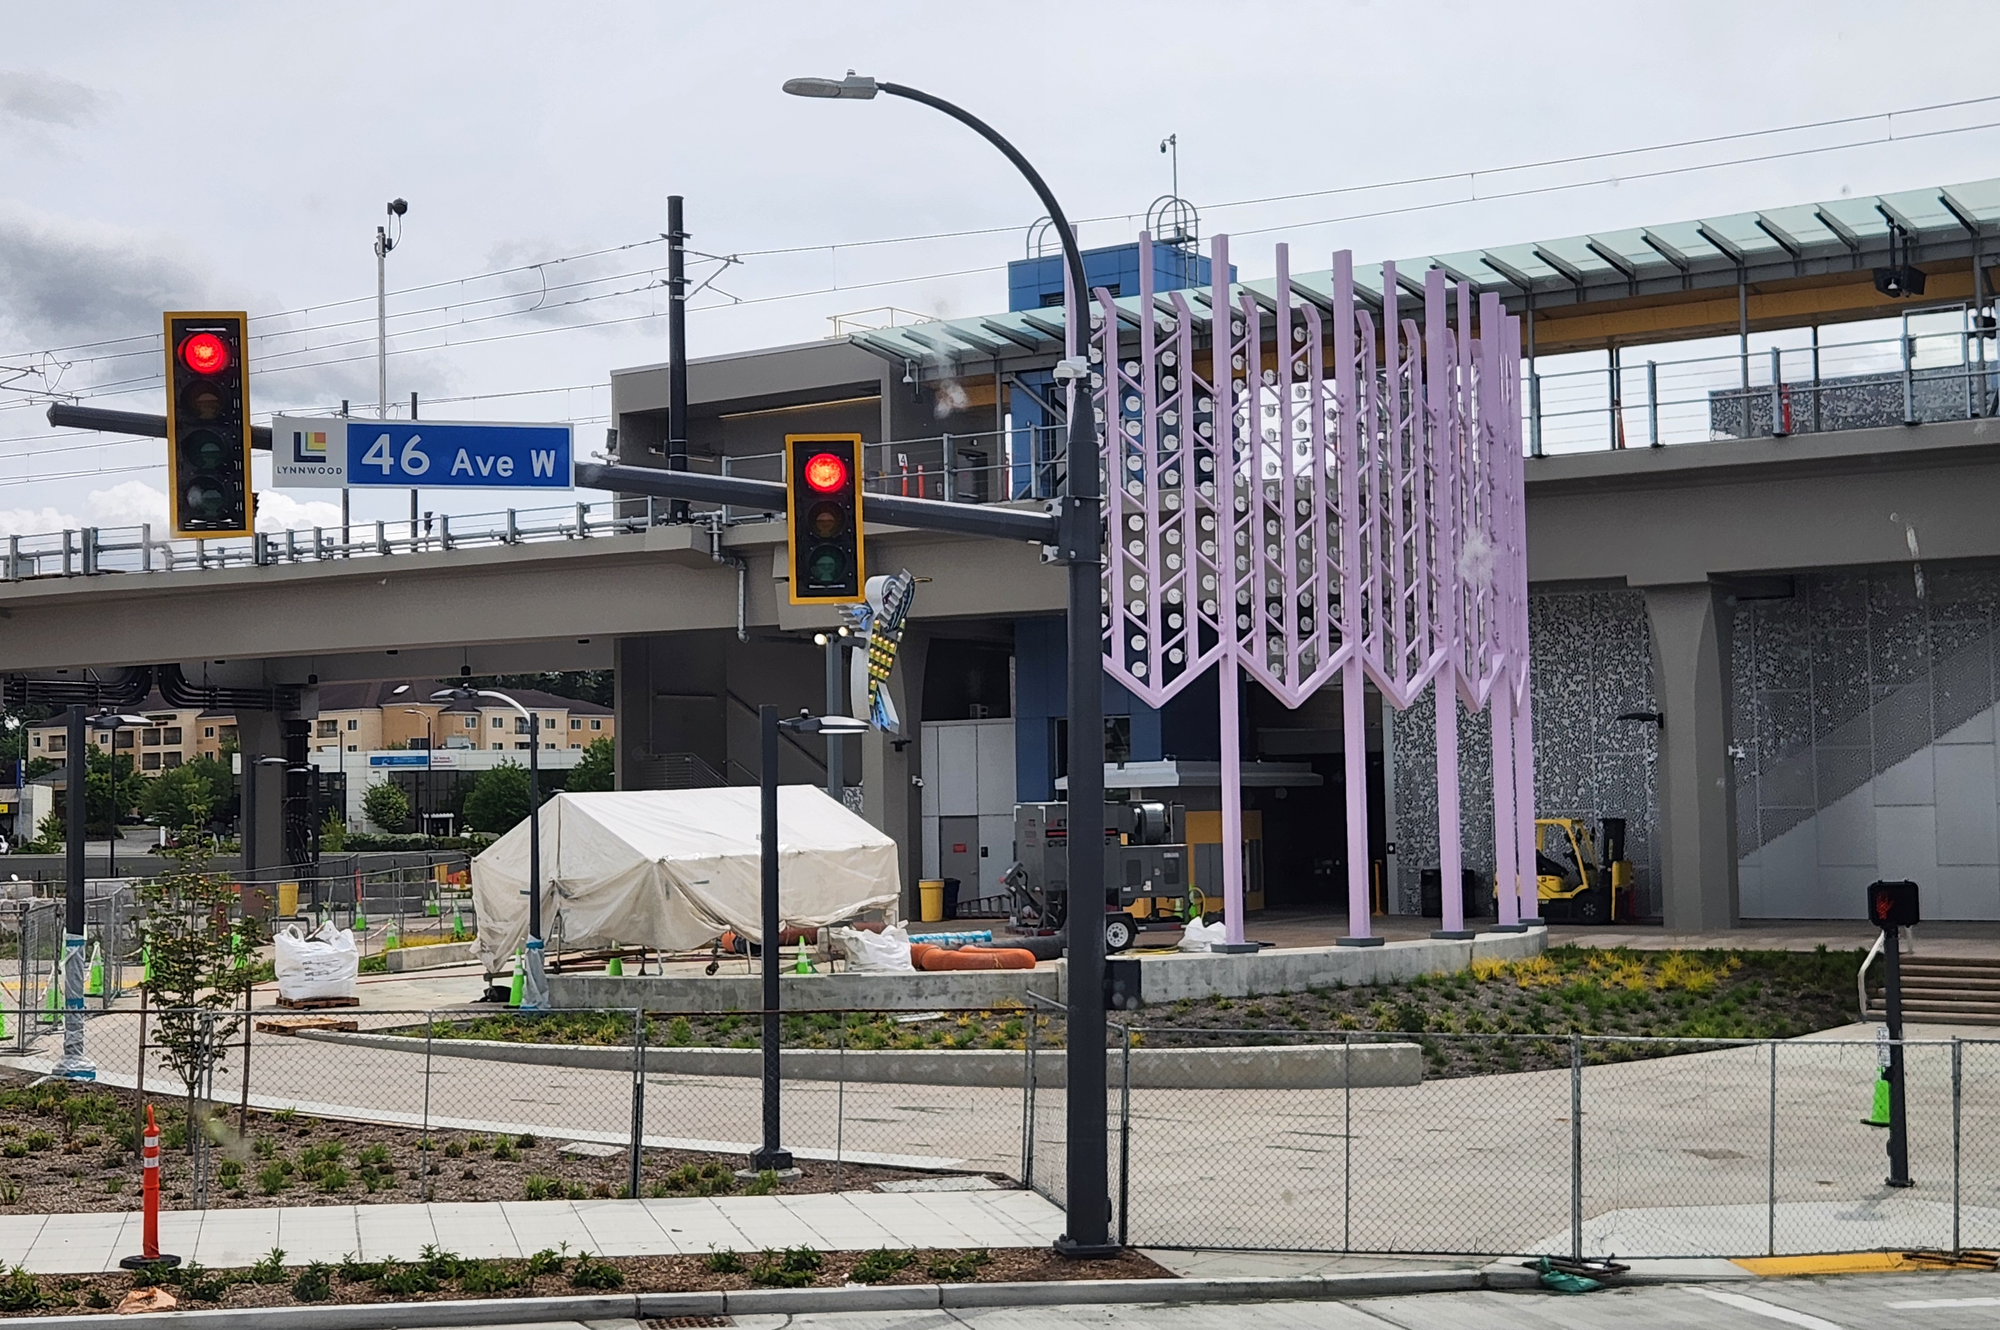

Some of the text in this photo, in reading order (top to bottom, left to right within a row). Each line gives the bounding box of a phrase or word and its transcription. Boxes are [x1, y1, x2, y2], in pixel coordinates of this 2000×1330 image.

[361, 433, 556, 477] 46 Ave W
[276, 466, 343, 475] LYNNWOOD
